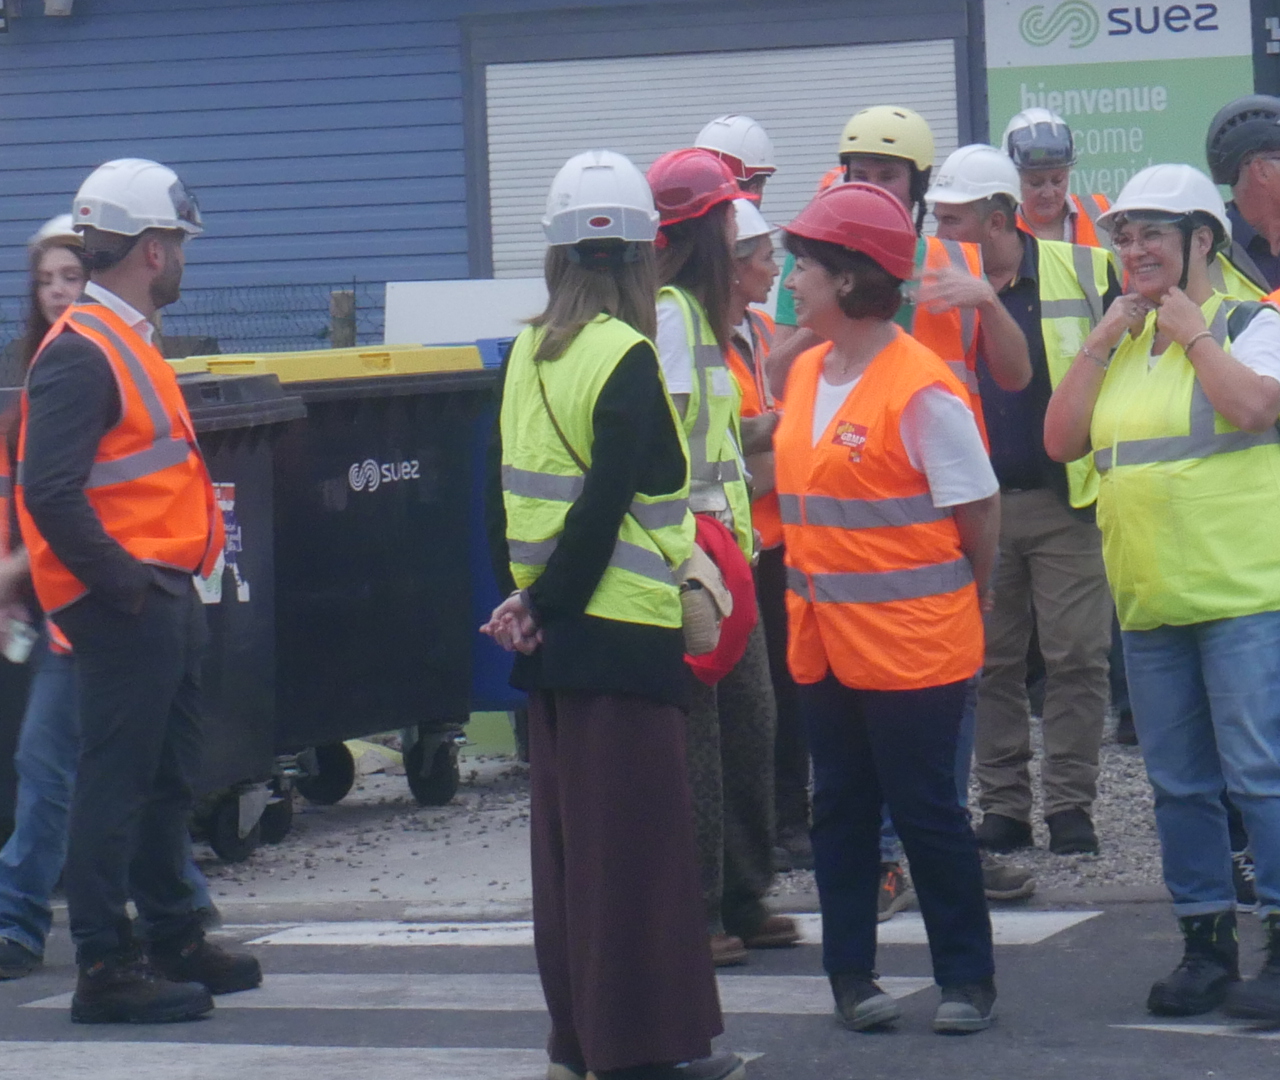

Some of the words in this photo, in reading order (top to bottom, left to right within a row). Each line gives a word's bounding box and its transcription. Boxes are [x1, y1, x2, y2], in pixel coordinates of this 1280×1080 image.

[1107, 2, 1220, 37] suez
[1020, 82, 1168, 116] bienvenue
[380, 459, 421, 483] suez
